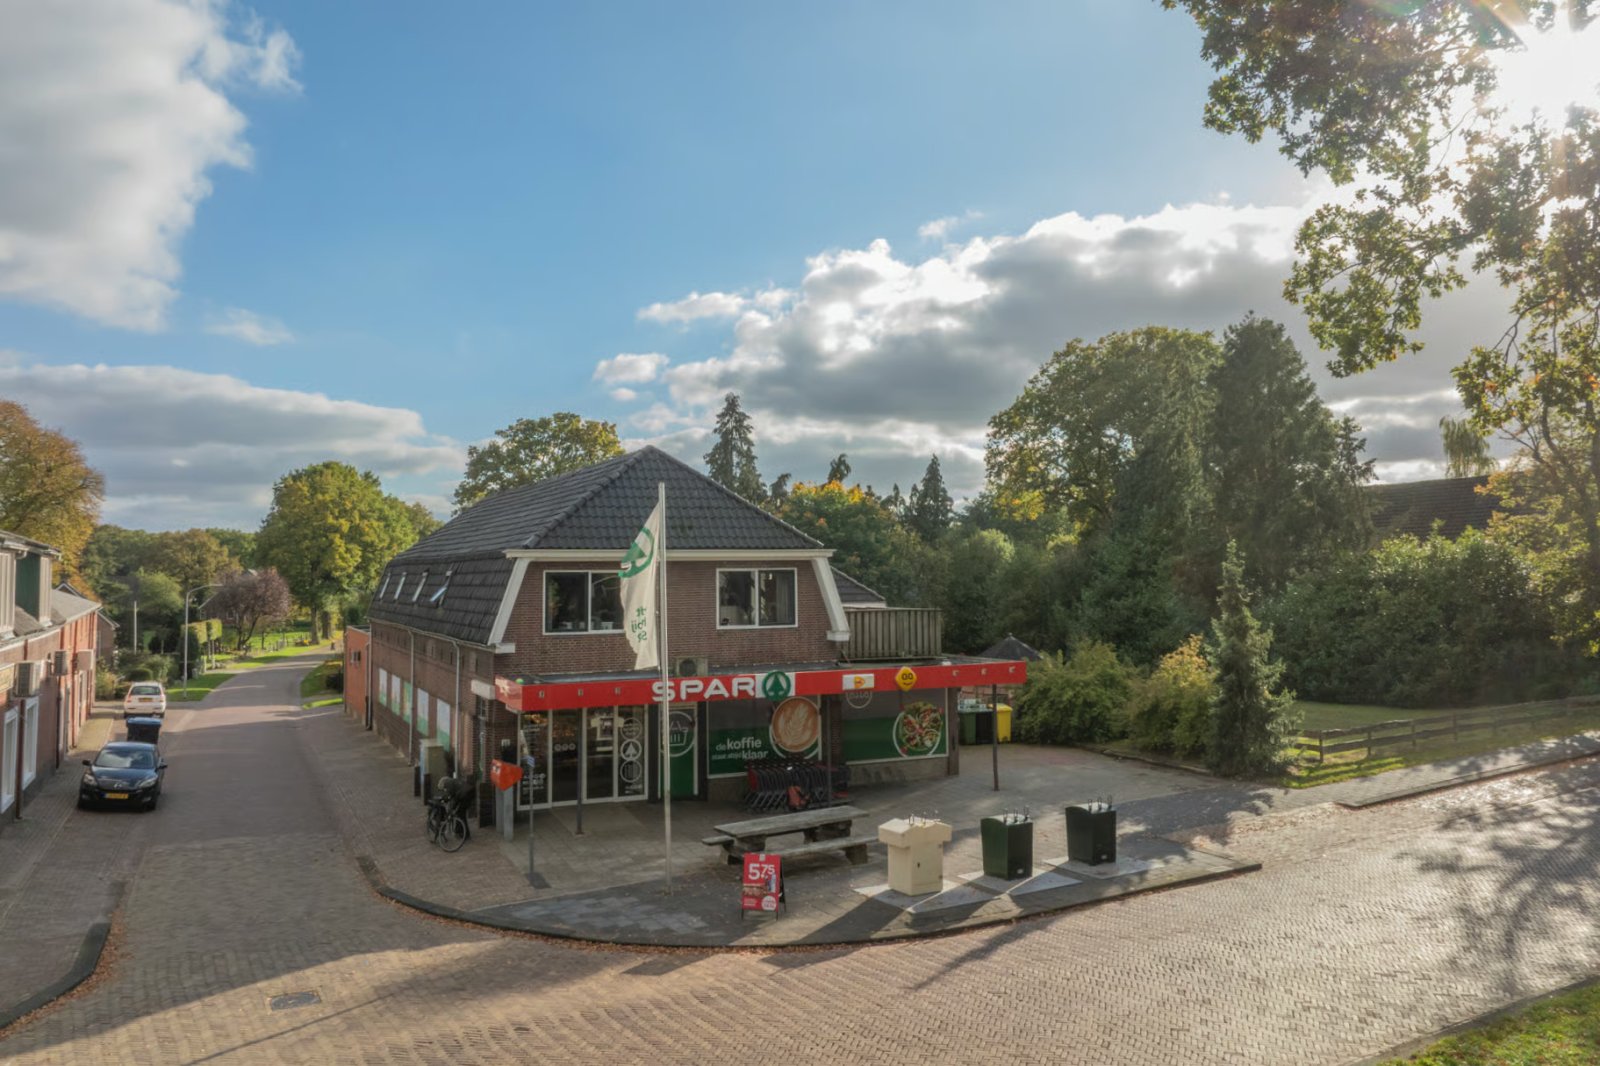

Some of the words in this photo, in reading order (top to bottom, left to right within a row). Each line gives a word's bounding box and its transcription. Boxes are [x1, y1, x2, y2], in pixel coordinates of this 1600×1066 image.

[652, 678, 755, 701] SPAR
[727, 736, 762, 750] koffie
[742, 750, 768, 760] klaar
